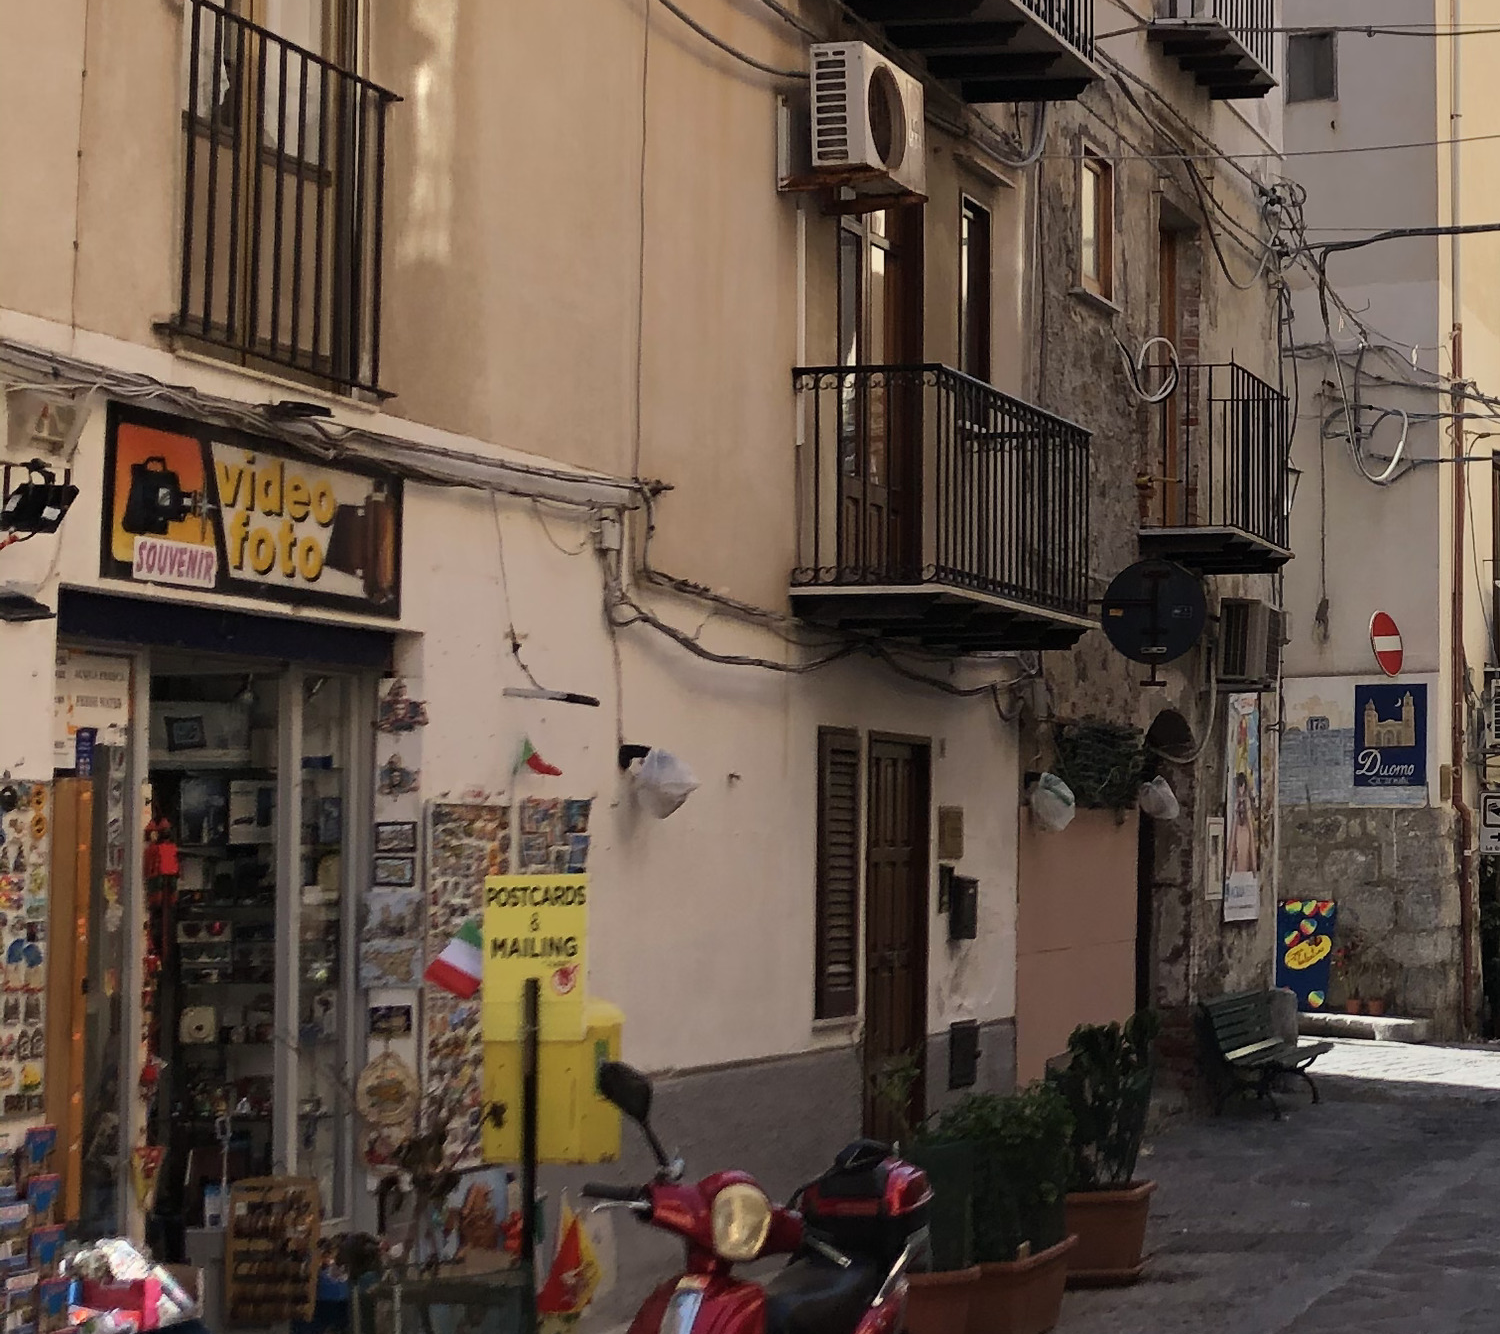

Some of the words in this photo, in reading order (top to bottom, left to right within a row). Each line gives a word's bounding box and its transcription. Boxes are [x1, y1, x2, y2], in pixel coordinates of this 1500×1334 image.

[214, 450, 335, 528] video
[136, 541, 214, 583] SOUVENIR
[229, 510, 324, 582] foto
[1355, 748, 1415, 776] Duomo
[486, 885, 587, 907] POSTCARDS
[490, 936, 578, 958] MAILING
